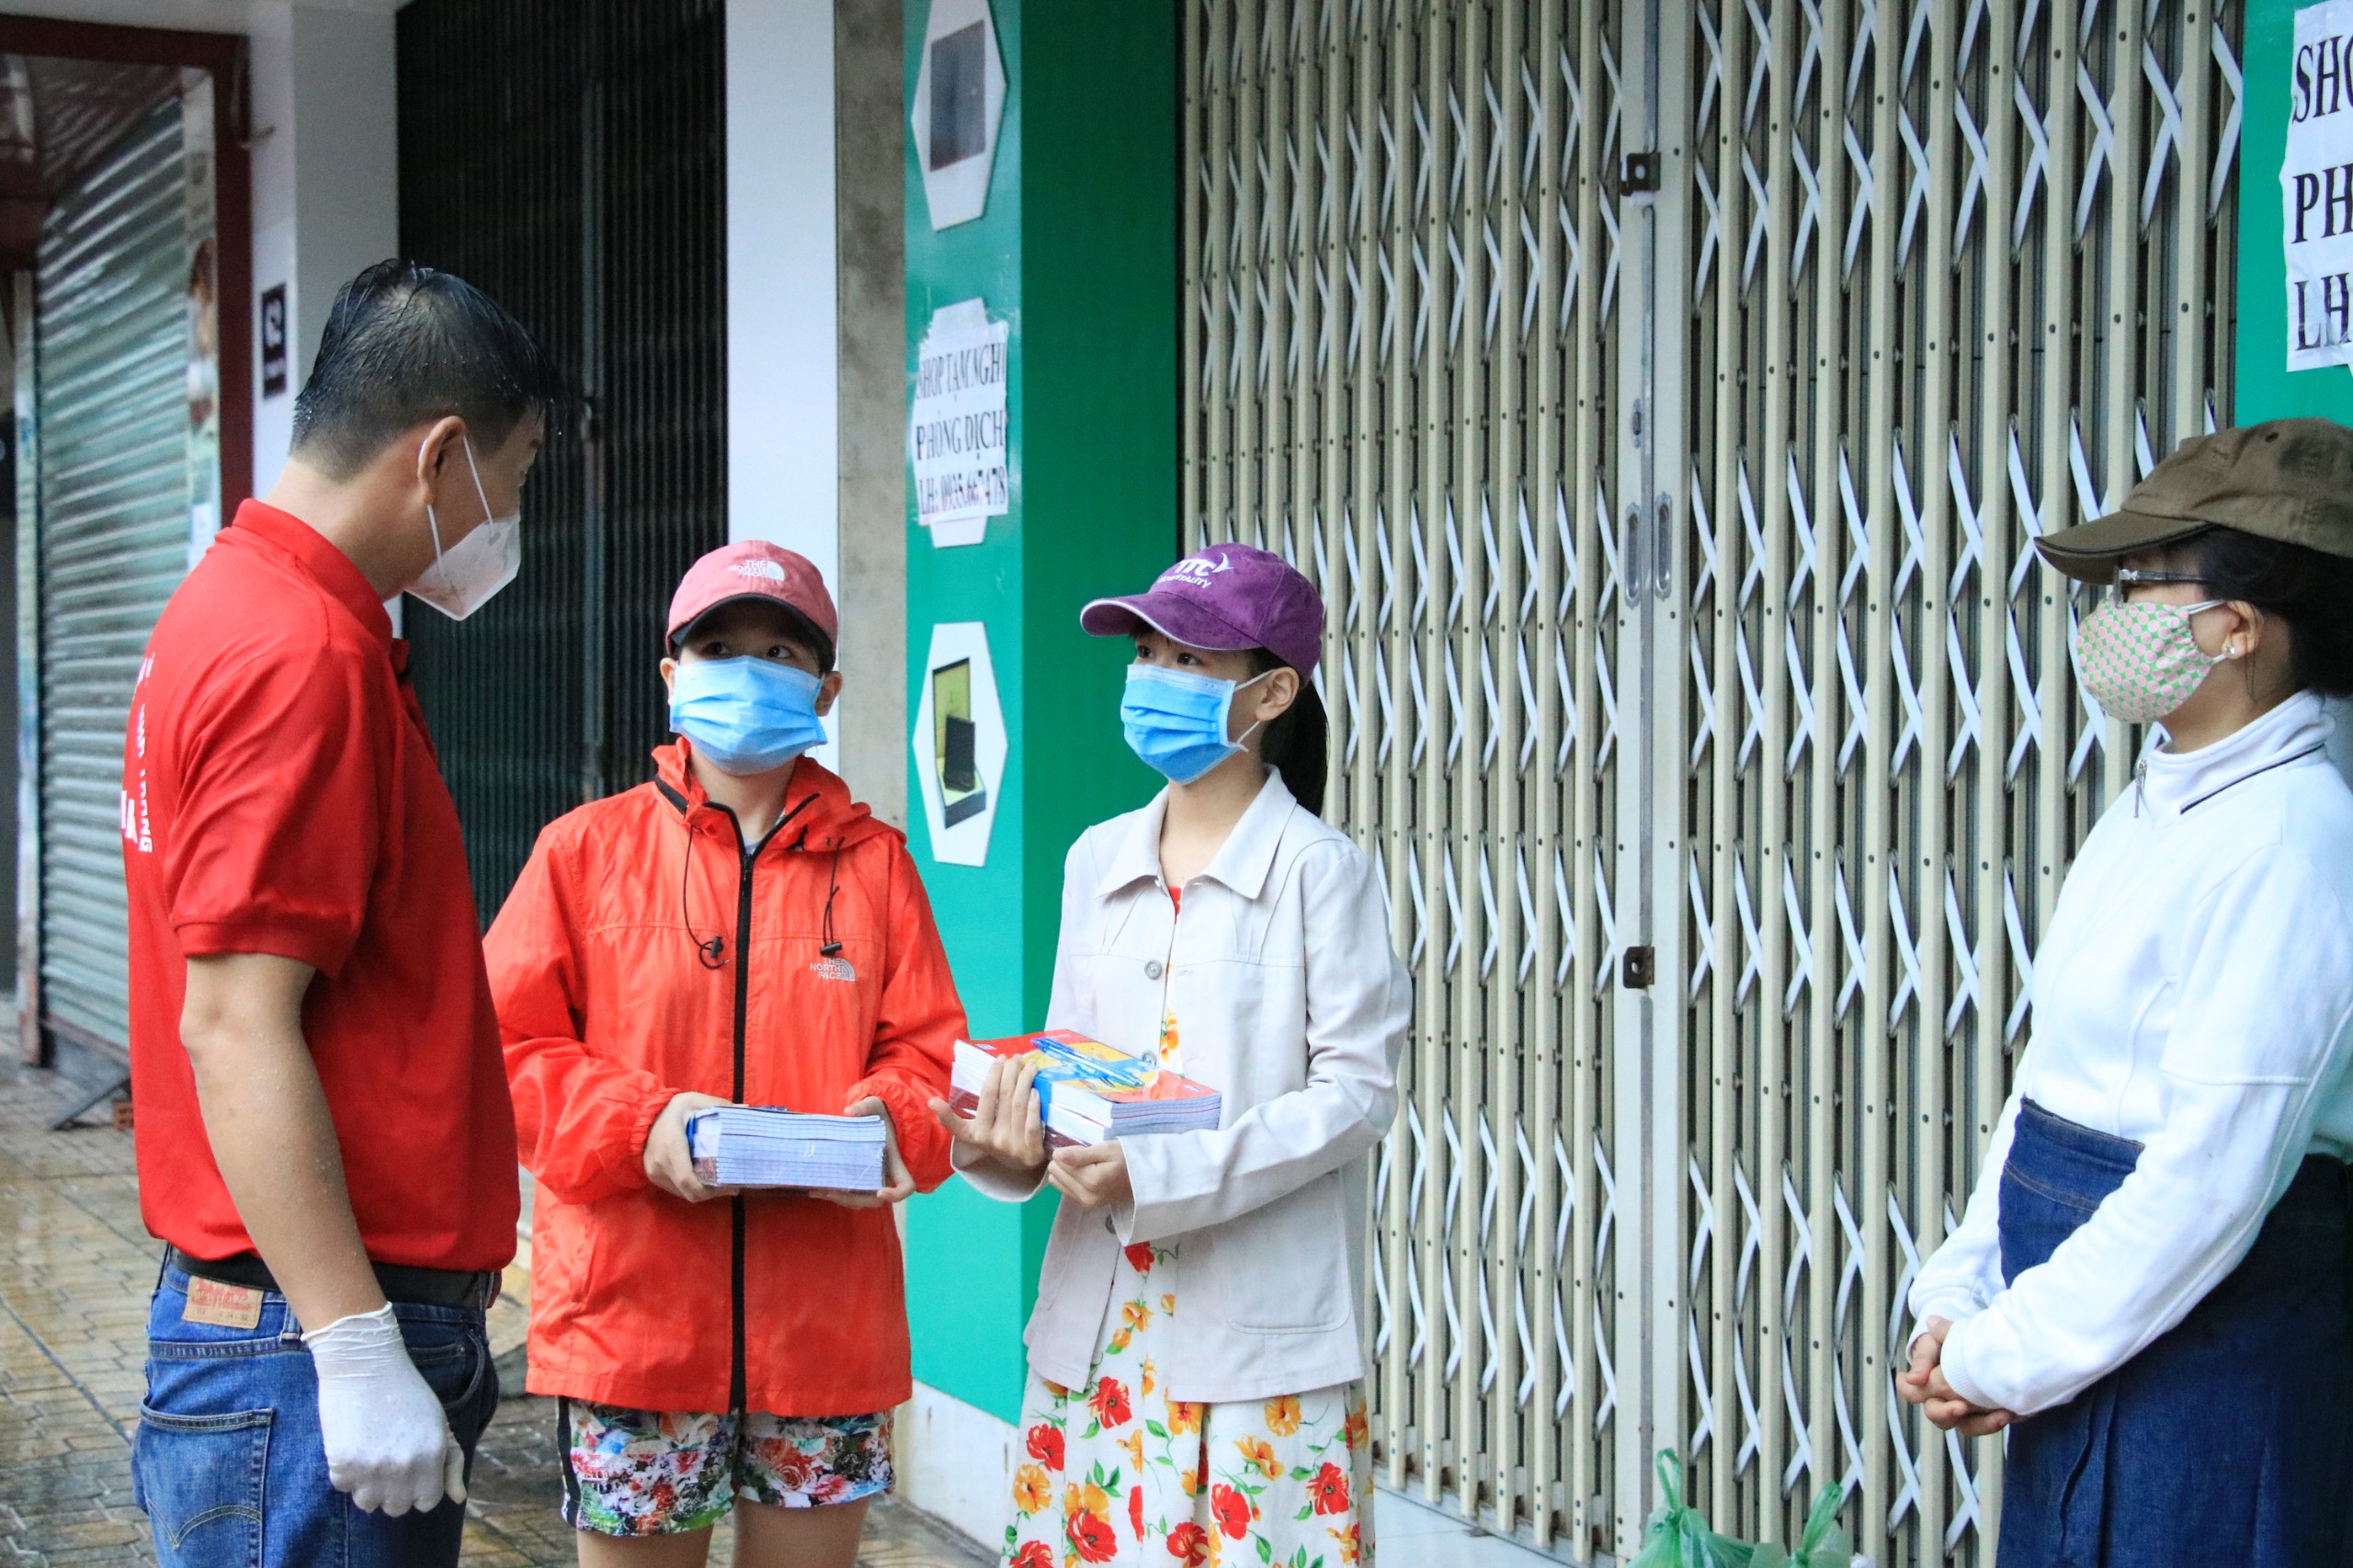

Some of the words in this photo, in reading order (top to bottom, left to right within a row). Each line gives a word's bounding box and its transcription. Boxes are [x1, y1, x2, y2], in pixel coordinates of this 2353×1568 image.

[964, 410, 1005, 460] DỊCH
[824, 957, 841, 965] THE
[810, 963, 841, 972] NORTH
[819, 971, 842, 980] FACE
